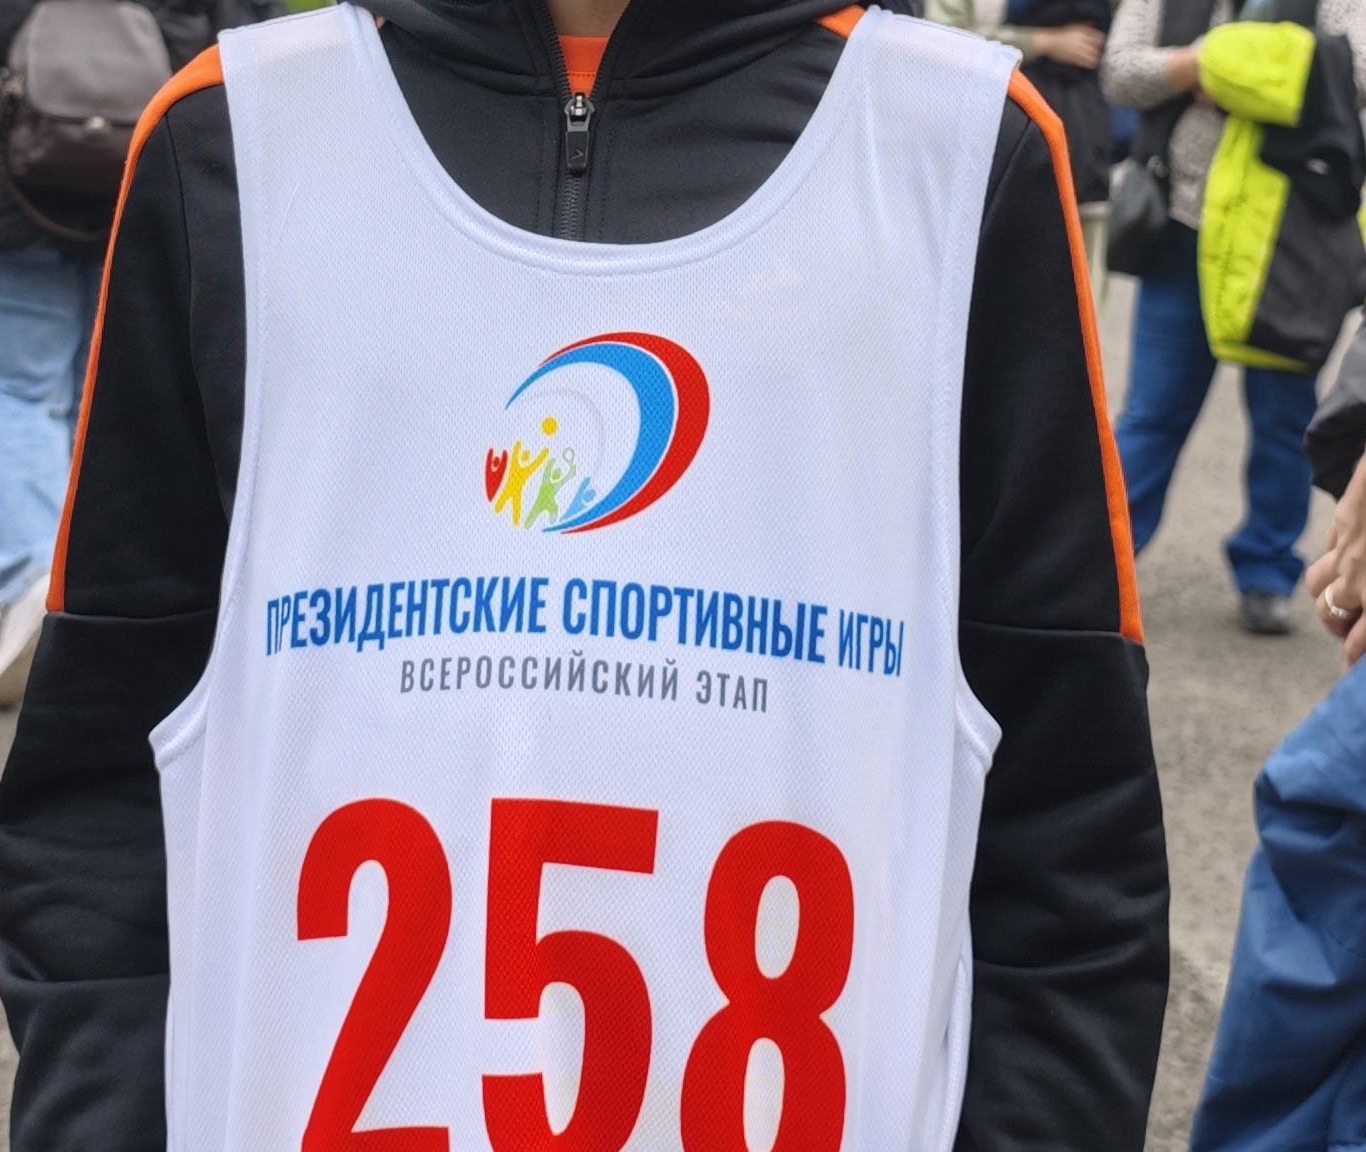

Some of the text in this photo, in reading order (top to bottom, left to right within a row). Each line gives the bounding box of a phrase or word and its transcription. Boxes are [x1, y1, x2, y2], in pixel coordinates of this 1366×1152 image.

[265, 576, 906, 677] ПРЕЗИДЕНТСКИЕ СПОРТИВНЫЕ ИГРЫ
[400, 651, 768, 713] ВСЕРОССИЙСКИЙ ЭТАП
[297, 797, 855, 1152] 258
